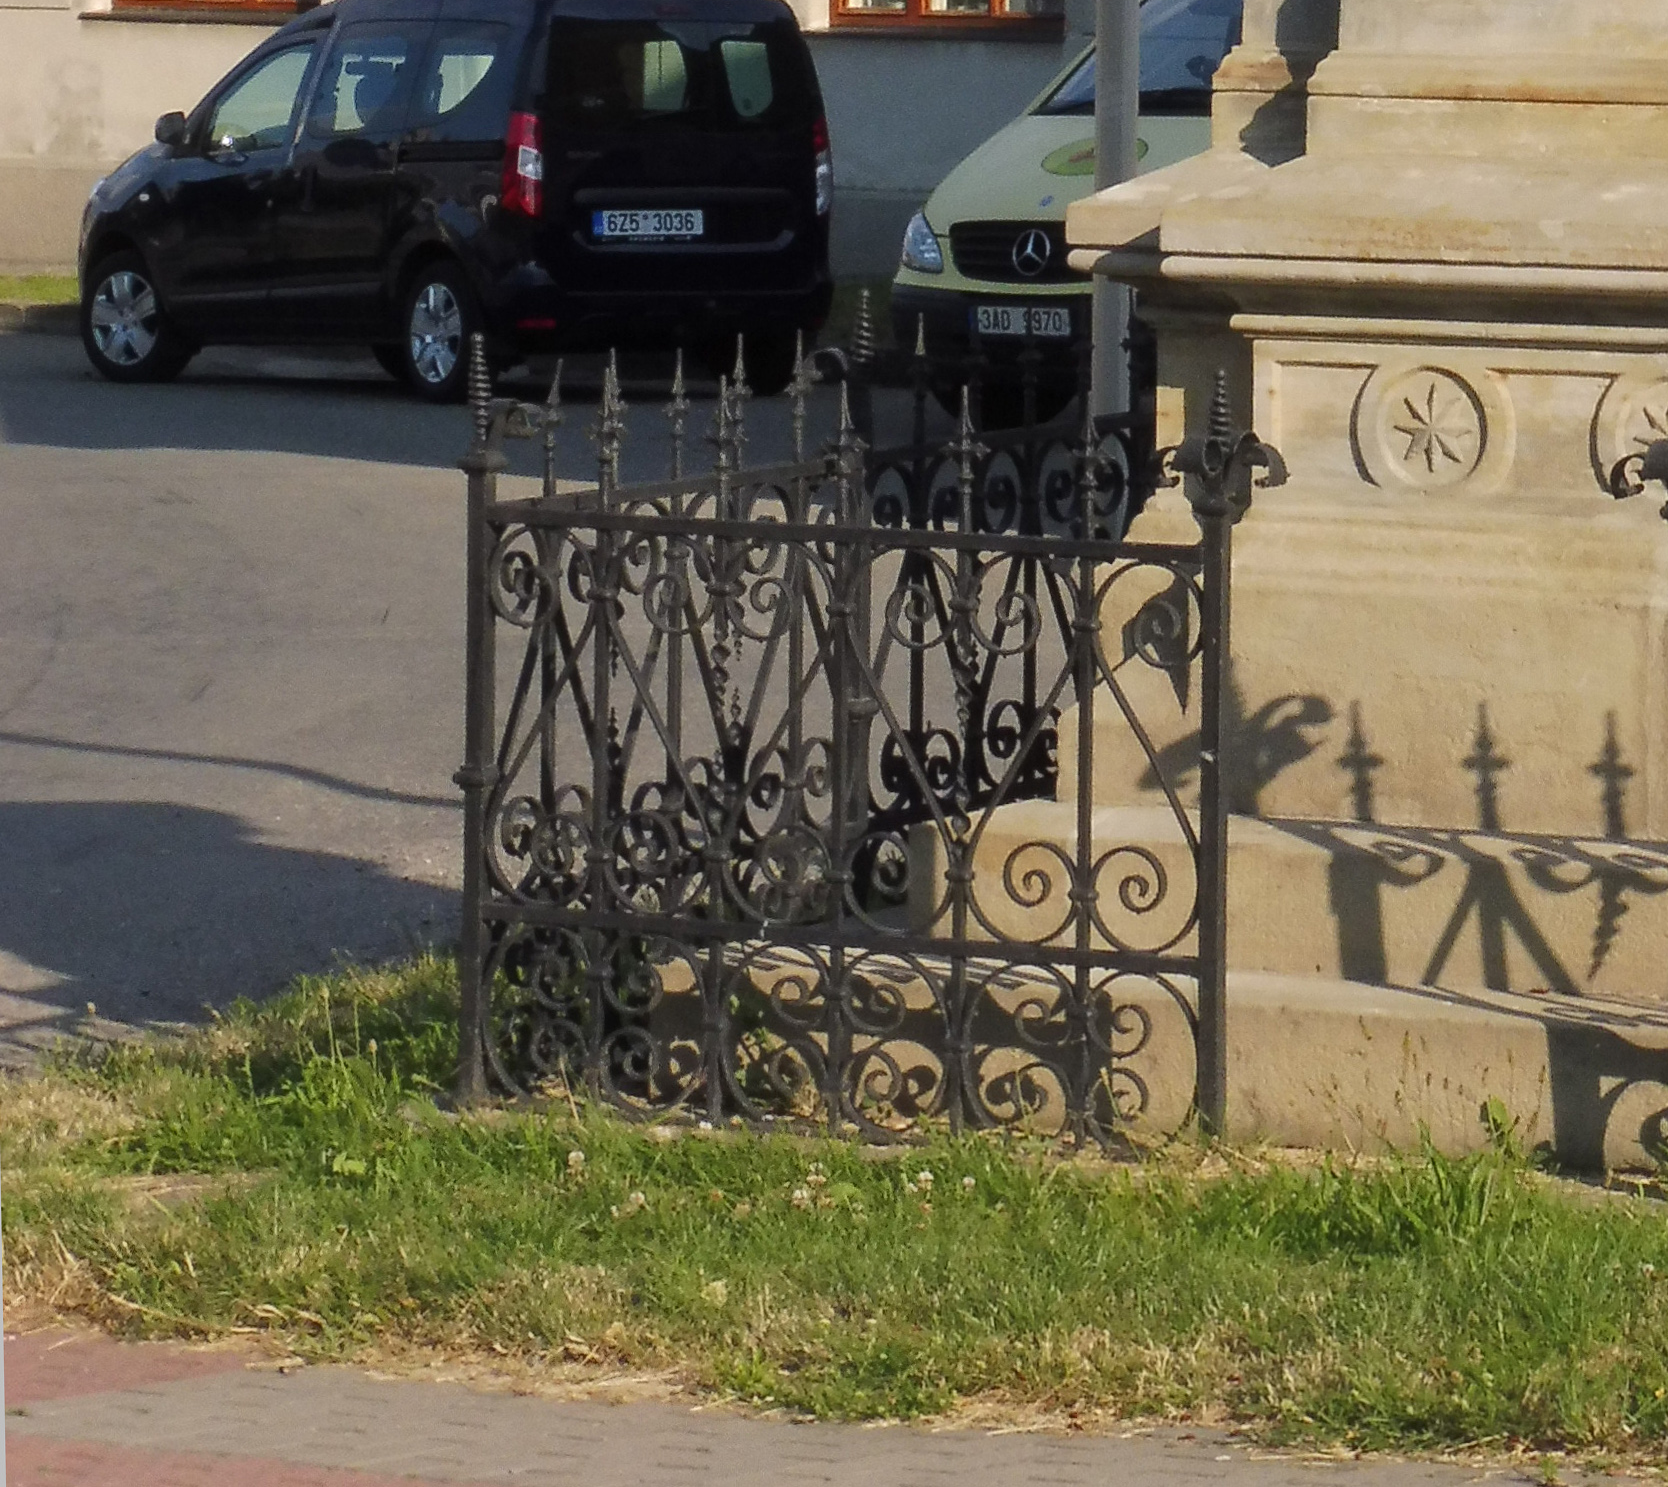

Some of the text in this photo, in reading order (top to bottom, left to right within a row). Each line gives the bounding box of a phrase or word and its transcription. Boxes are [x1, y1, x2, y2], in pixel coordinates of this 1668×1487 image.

[607, 213, 640, 232] 6Z5
[653, 213, 694, 232] 3036
[982, 309, 1011, 330] 3AD
